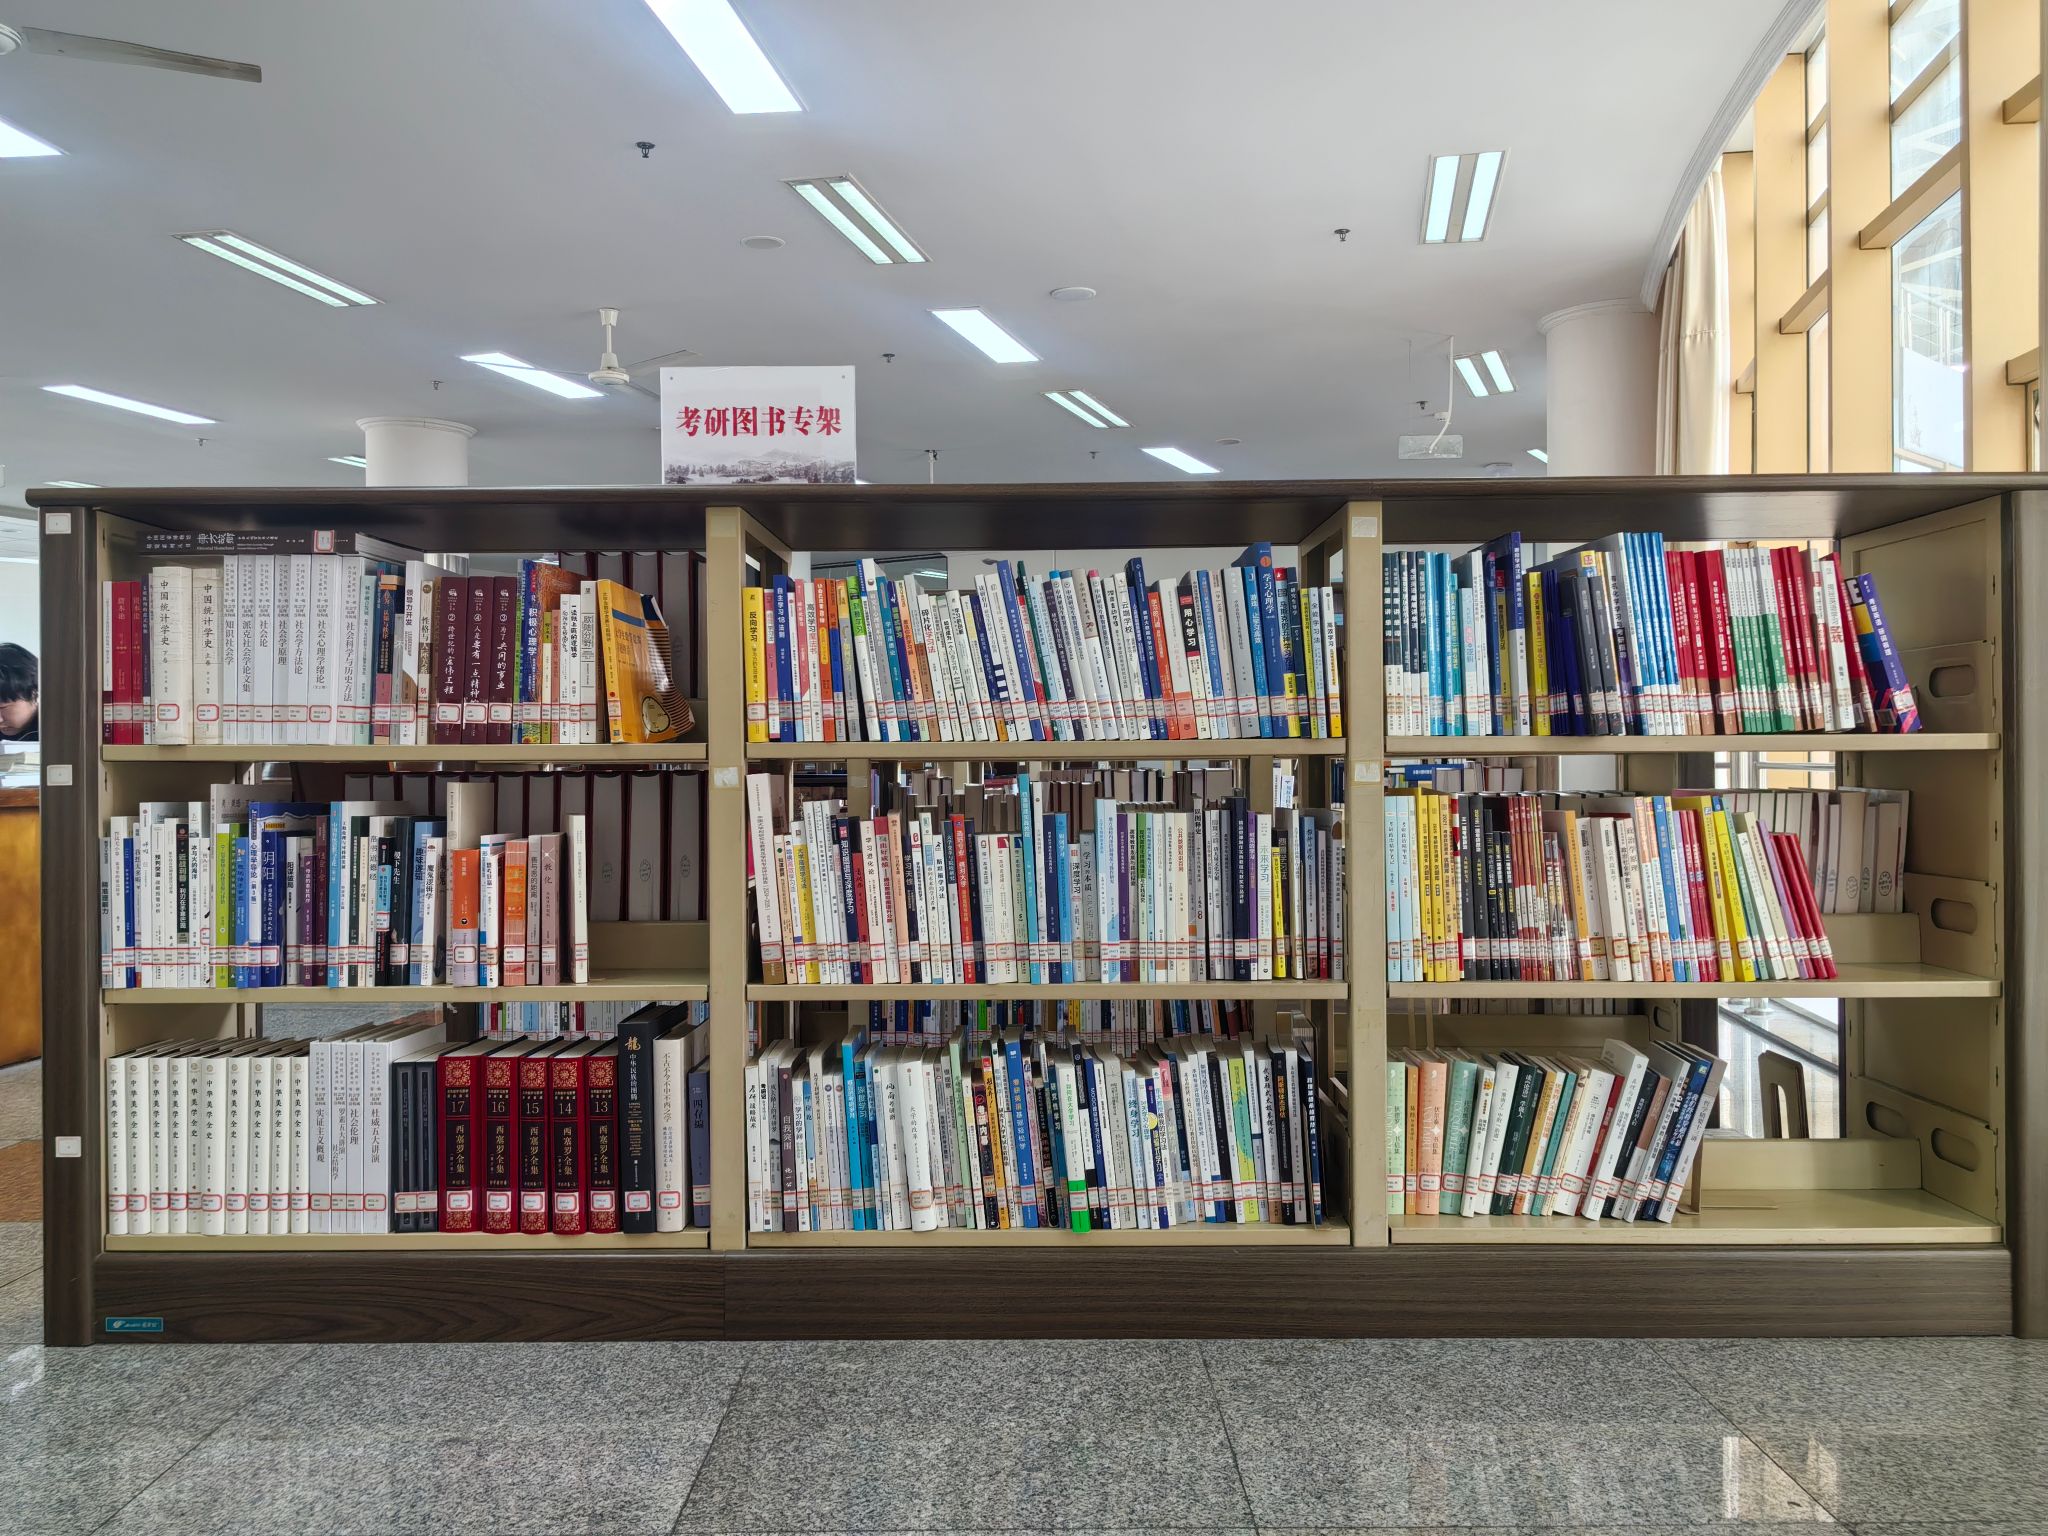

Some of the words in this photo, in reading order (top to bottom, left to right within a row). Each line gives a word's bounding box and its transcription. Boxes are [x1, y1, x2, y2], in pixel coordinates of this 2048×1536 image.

[676, 406, 842, 437] 考研图书专架
[160, 580, 170, 646] 中国统计学史
[203, 584, 213, 648] 中国统计学史
[405, 589, 414, 626] 领导力开发
[1263, 573, 1275, 614] 学习心理学
[224, 620, 235, 665] 知识社会学
[259, 620, 269, 648] 社会论
[277, 620, 288, 666] 社会学原理
[294, 620, 304, 674] 社会学方法论
[1183, 608, 1196, 647] 用心学习
[241, 621, 251, 692] 派克社会学论文集
[316, 620, 326, 684] 社会心理学绪论
[262, 851, 275, 880] 阴阳
[866, 837, 874, 875] 学习进化论
[1072, 862, 1081, 894] 深度学习
[110, 1079, 118, 1139] 中华美学全史
[130, 1079, 138, 1139] 中华美学全史
[254, 1079, 262, 1139] 中华美学全史
[350, 1108, 359, 1145] 社会伦理
[452, 1100, 465, 1113] 17
[491, 1101, 505, 1113] 16
[525, 1102, 540, 1114] 15
[559, 1102, 573, 1115] 14
[595, 1101, 608, 1113] 13
[315, 1108, 325, 1163] 实证主义概观
[371, 1108, 381, 1164] 杜威五大讲演
[456, 1125, 465, 1173] 西塞罗全集
[495, 1125, 505, 1174] 西塞罗全集
[530, 1127, 539, 1175] 西塞罗全集
[563, 1127, 573, 1176] 西塞罗全集
[600, 1125, 609, 1174] 西塞罗全集
[783, 1115, 792, 1151] 自我突围
